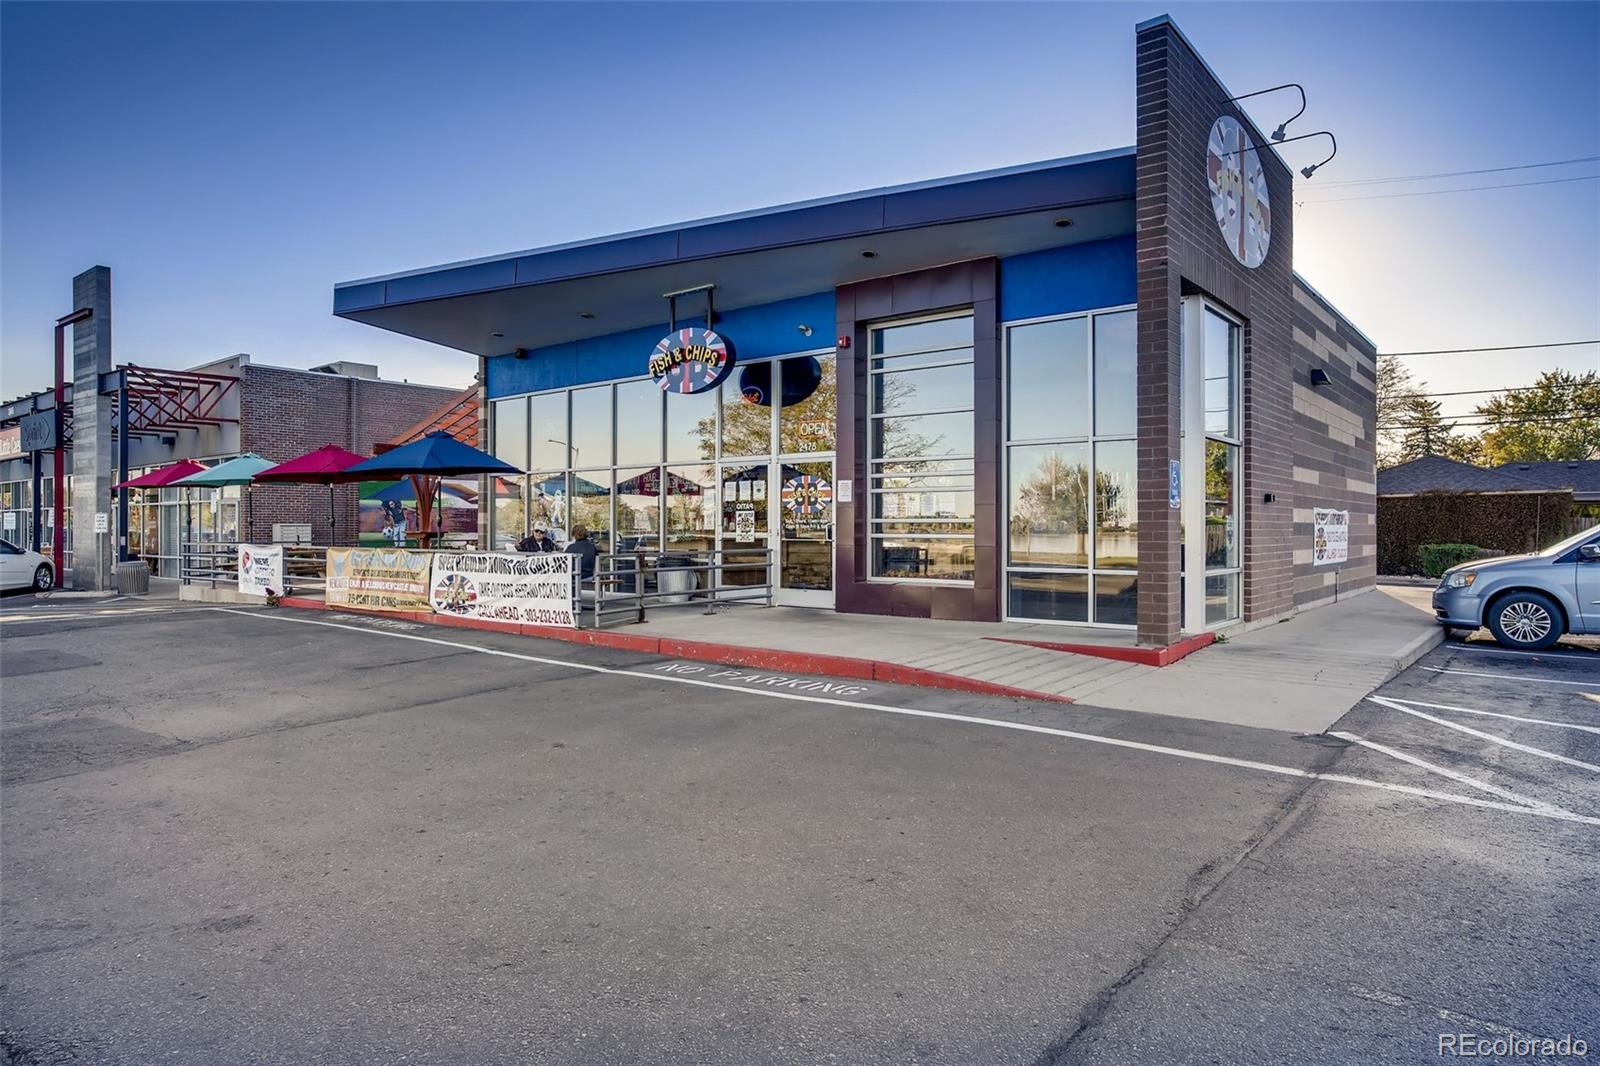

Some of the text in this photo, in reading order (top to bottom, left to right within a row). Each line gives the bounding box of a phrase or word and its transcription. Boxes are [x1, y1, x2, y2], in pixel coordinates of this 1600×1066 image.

[649, 345, 718, 377] FISH & CHIPS
[800, 423, 828, 436] OPEN
[455, 555, 488, 573] REGULAR
[488, 556, 512, 575] HOURS
[512, 560, 529, 575] FOR
[478, 604, 495, 618] CALL
[495, 606, 519, 620] AHEAD
[524, 608, 571, 624] 303-232-2128
[654, 663, 868, 696] NO PARKING
